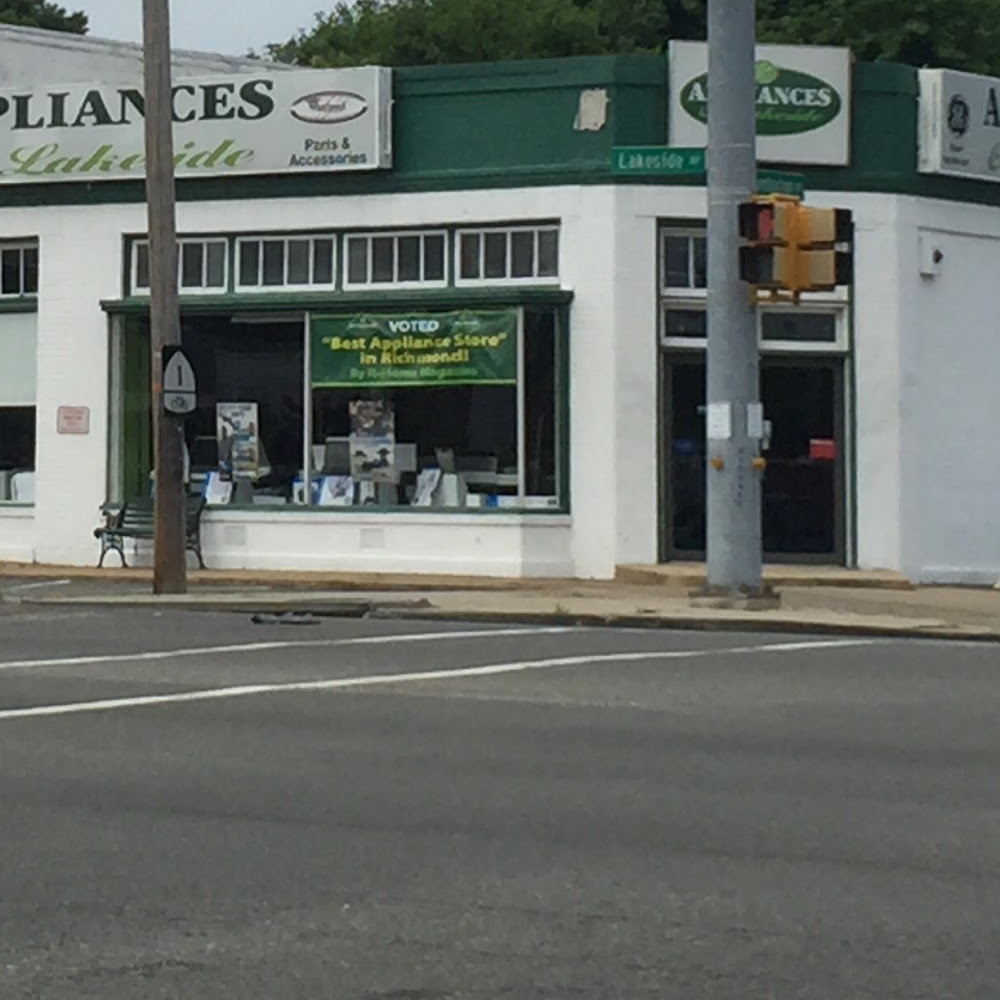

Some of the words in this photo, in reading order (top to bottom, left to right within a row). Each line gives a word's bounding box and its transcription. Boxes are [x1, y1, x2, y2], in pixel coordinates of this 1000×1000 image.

[304, 138, 338, 152] Parts
[341, 136, 351, 150] &
[0, 138, 255, 176] Lakeide
[289, 151, 368, 167] Accessories
[617, 152, 685, 170] Lakeside
[388, 320, 440, 333] VOTED
[369, 336, 452, 351] Appliance
[360, 351, 376, 365] in
